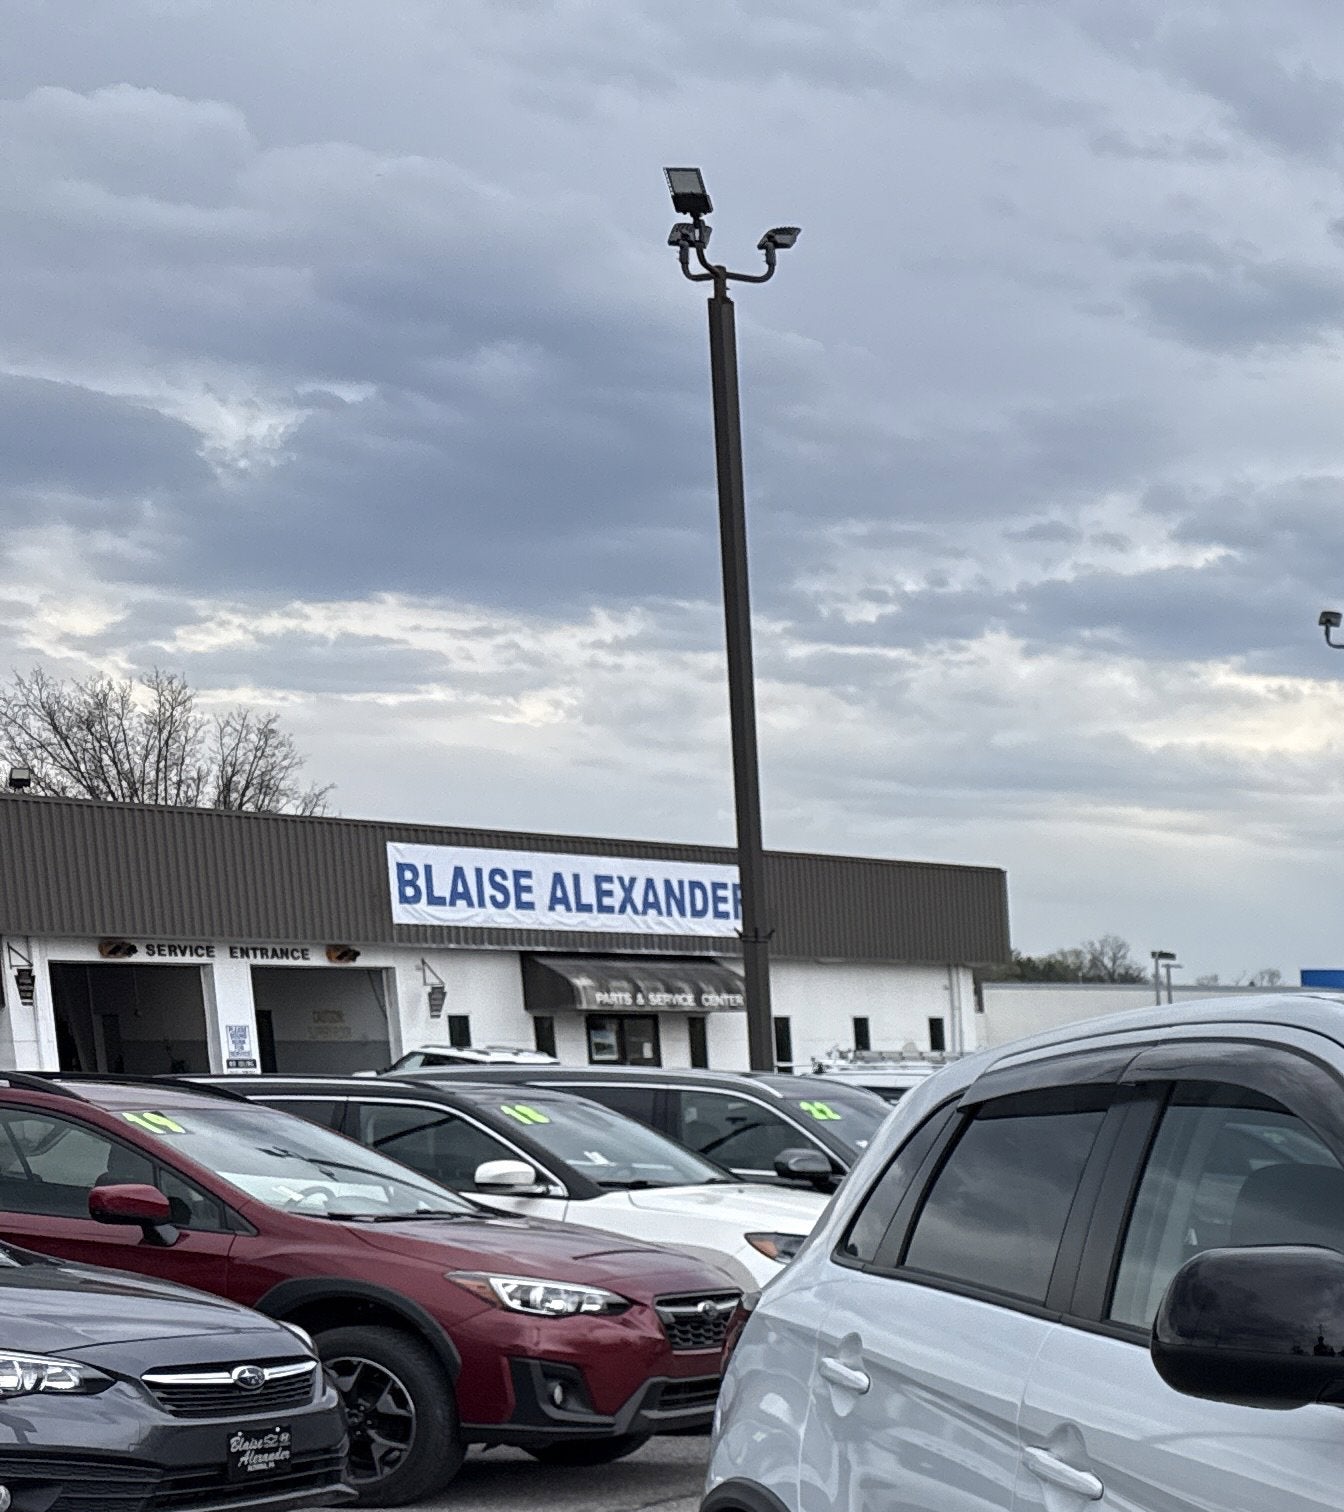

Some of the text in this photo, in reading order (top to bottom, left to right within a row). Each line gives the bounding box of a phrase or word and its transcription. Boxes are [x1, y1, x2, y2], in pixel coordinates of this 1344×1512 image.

[396, 861, 536, 911] BLAISE
[145, 943, 311, 961] SERVICE ENTRANCE
[595, 991, 744, 1007] PARTS & SERVICE CENTER
[800, 1101, 842, 1120] 22
